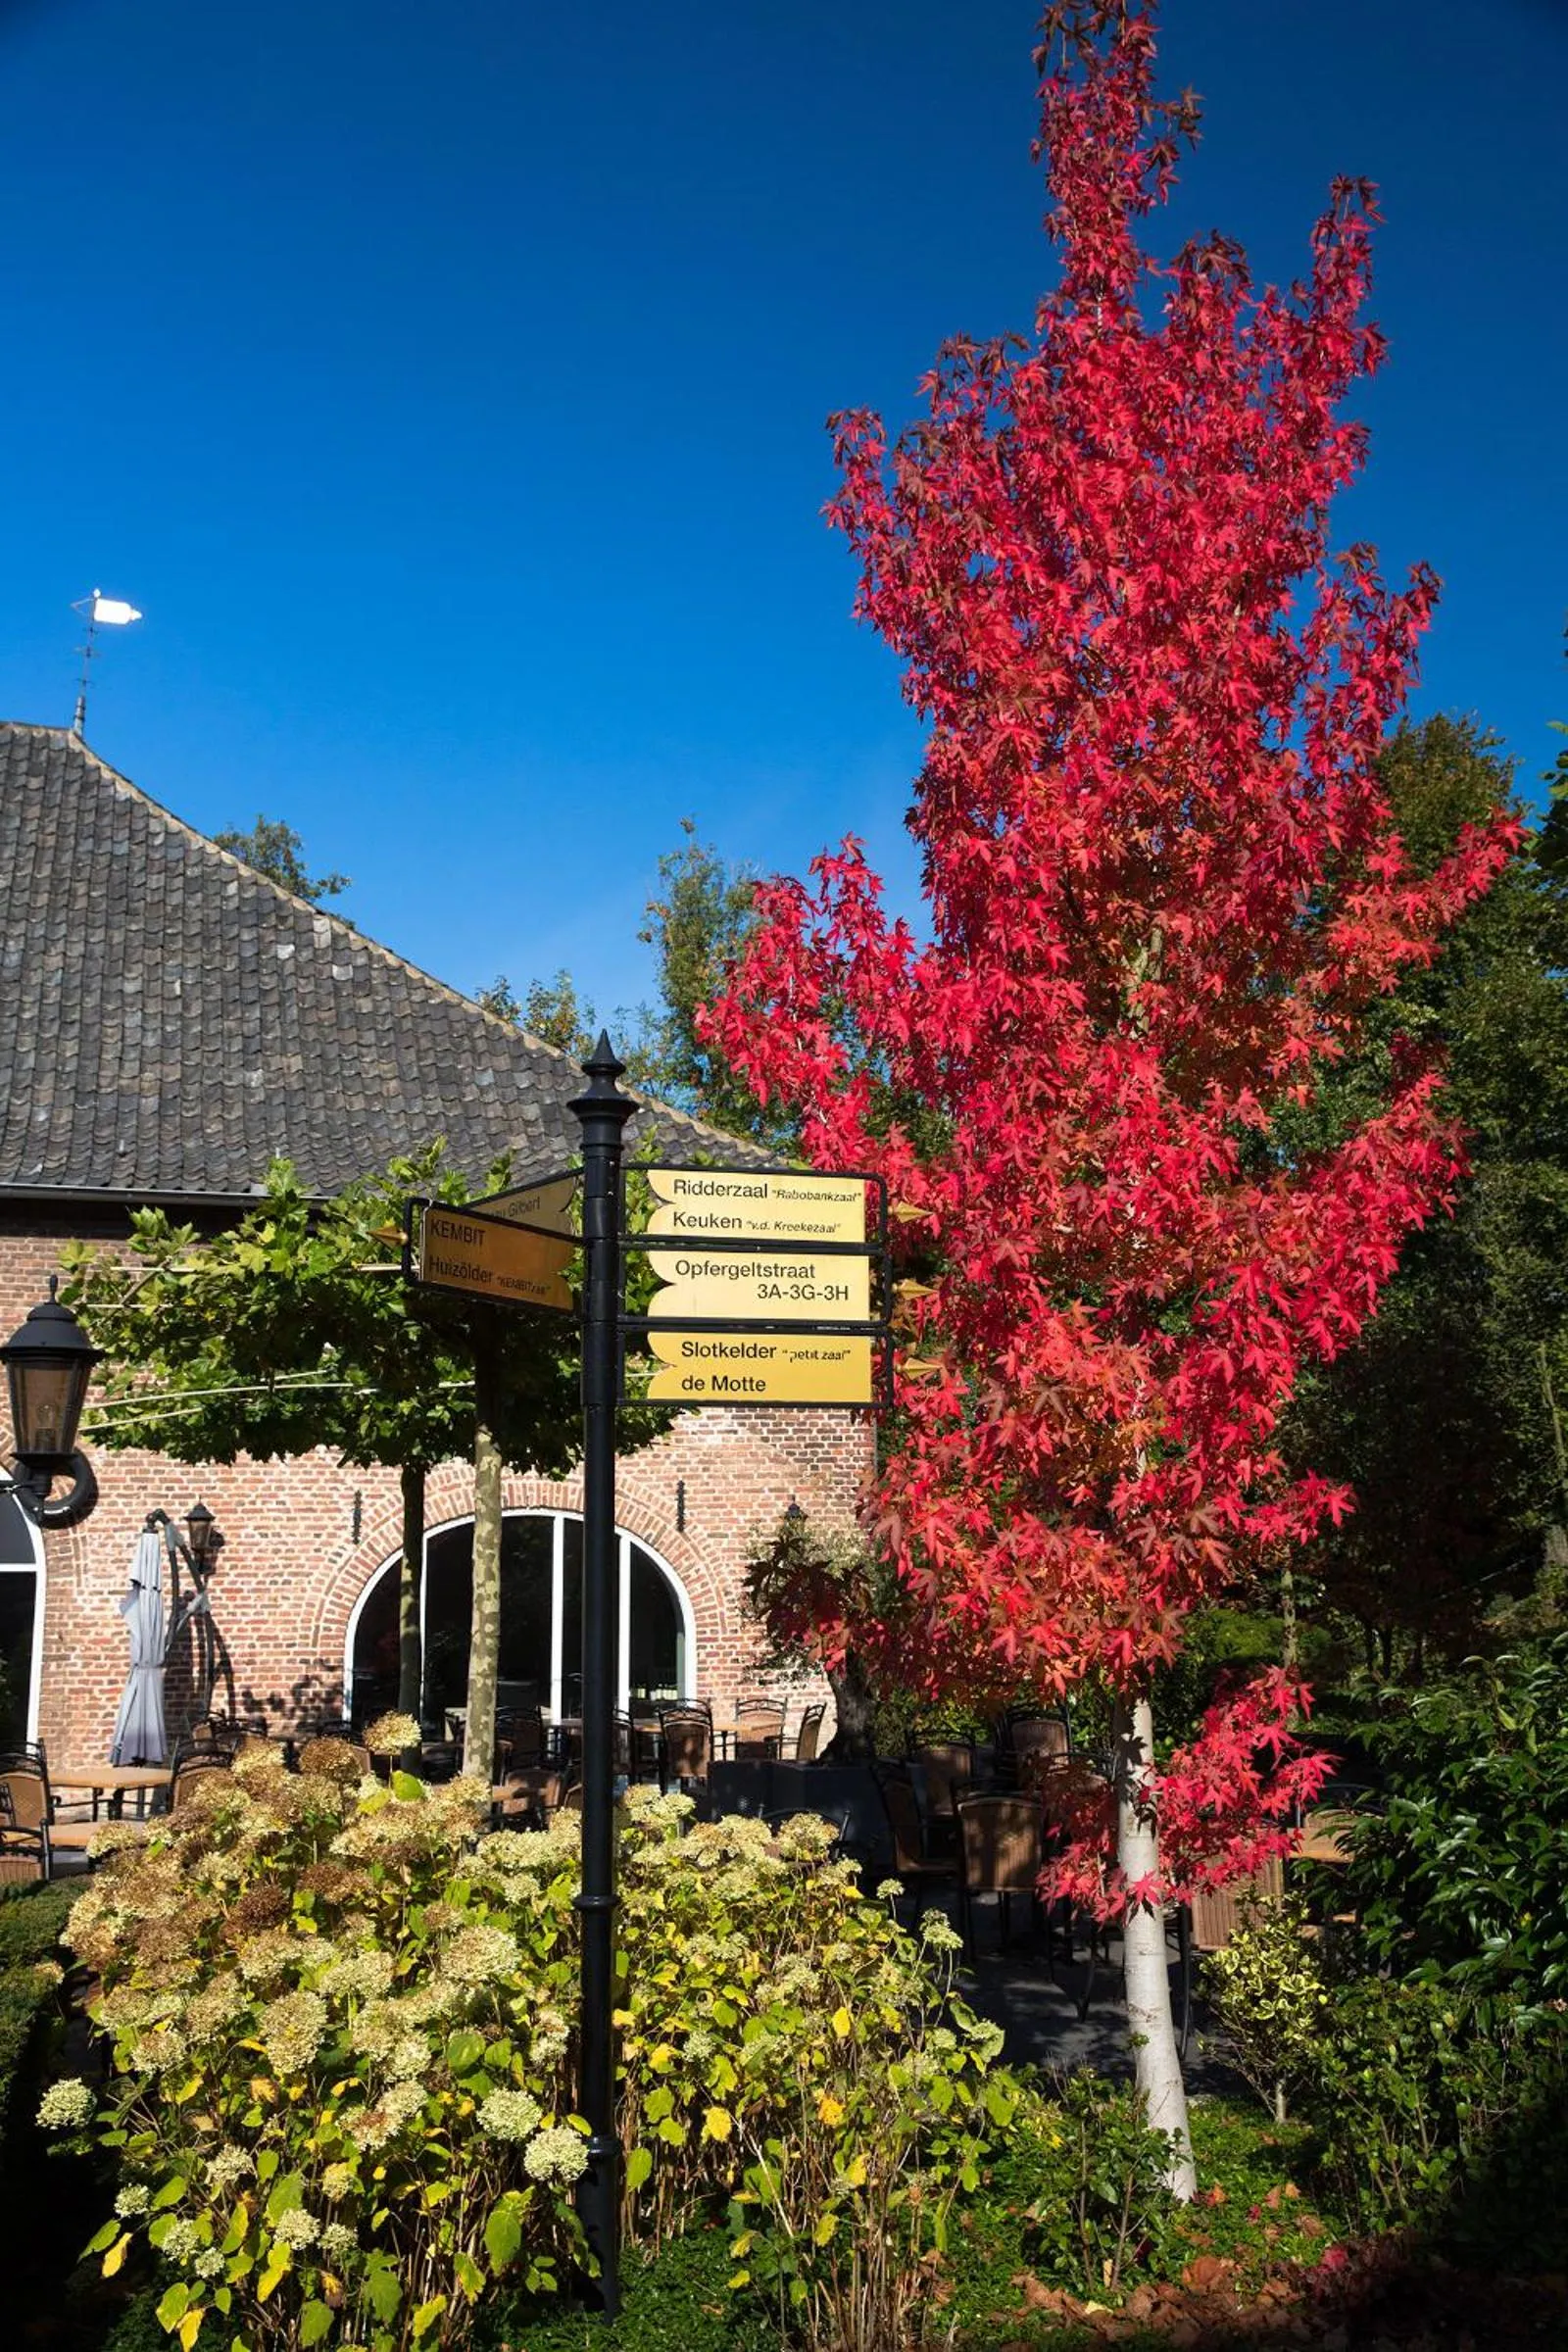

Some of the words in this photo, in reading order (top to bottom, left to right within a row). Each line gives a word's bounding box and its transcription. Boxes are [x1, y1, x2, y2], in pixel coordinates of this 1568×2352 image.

[673, 1178, 768, 1199] Ridderzaal
[673, 1211, 743, 1230] Keuken
[430, 1218, 486, 1247] KEMBIT
[675, 1259, 815, 1280] Opfergeltstraat
[757, 1284, 849, 1301] 3A-3G-3H
[681, 1341, 777, 1359] Slotkelder
[681, 1375, 706, 1392] de
[710, 1375, 766, 1393] Motte
